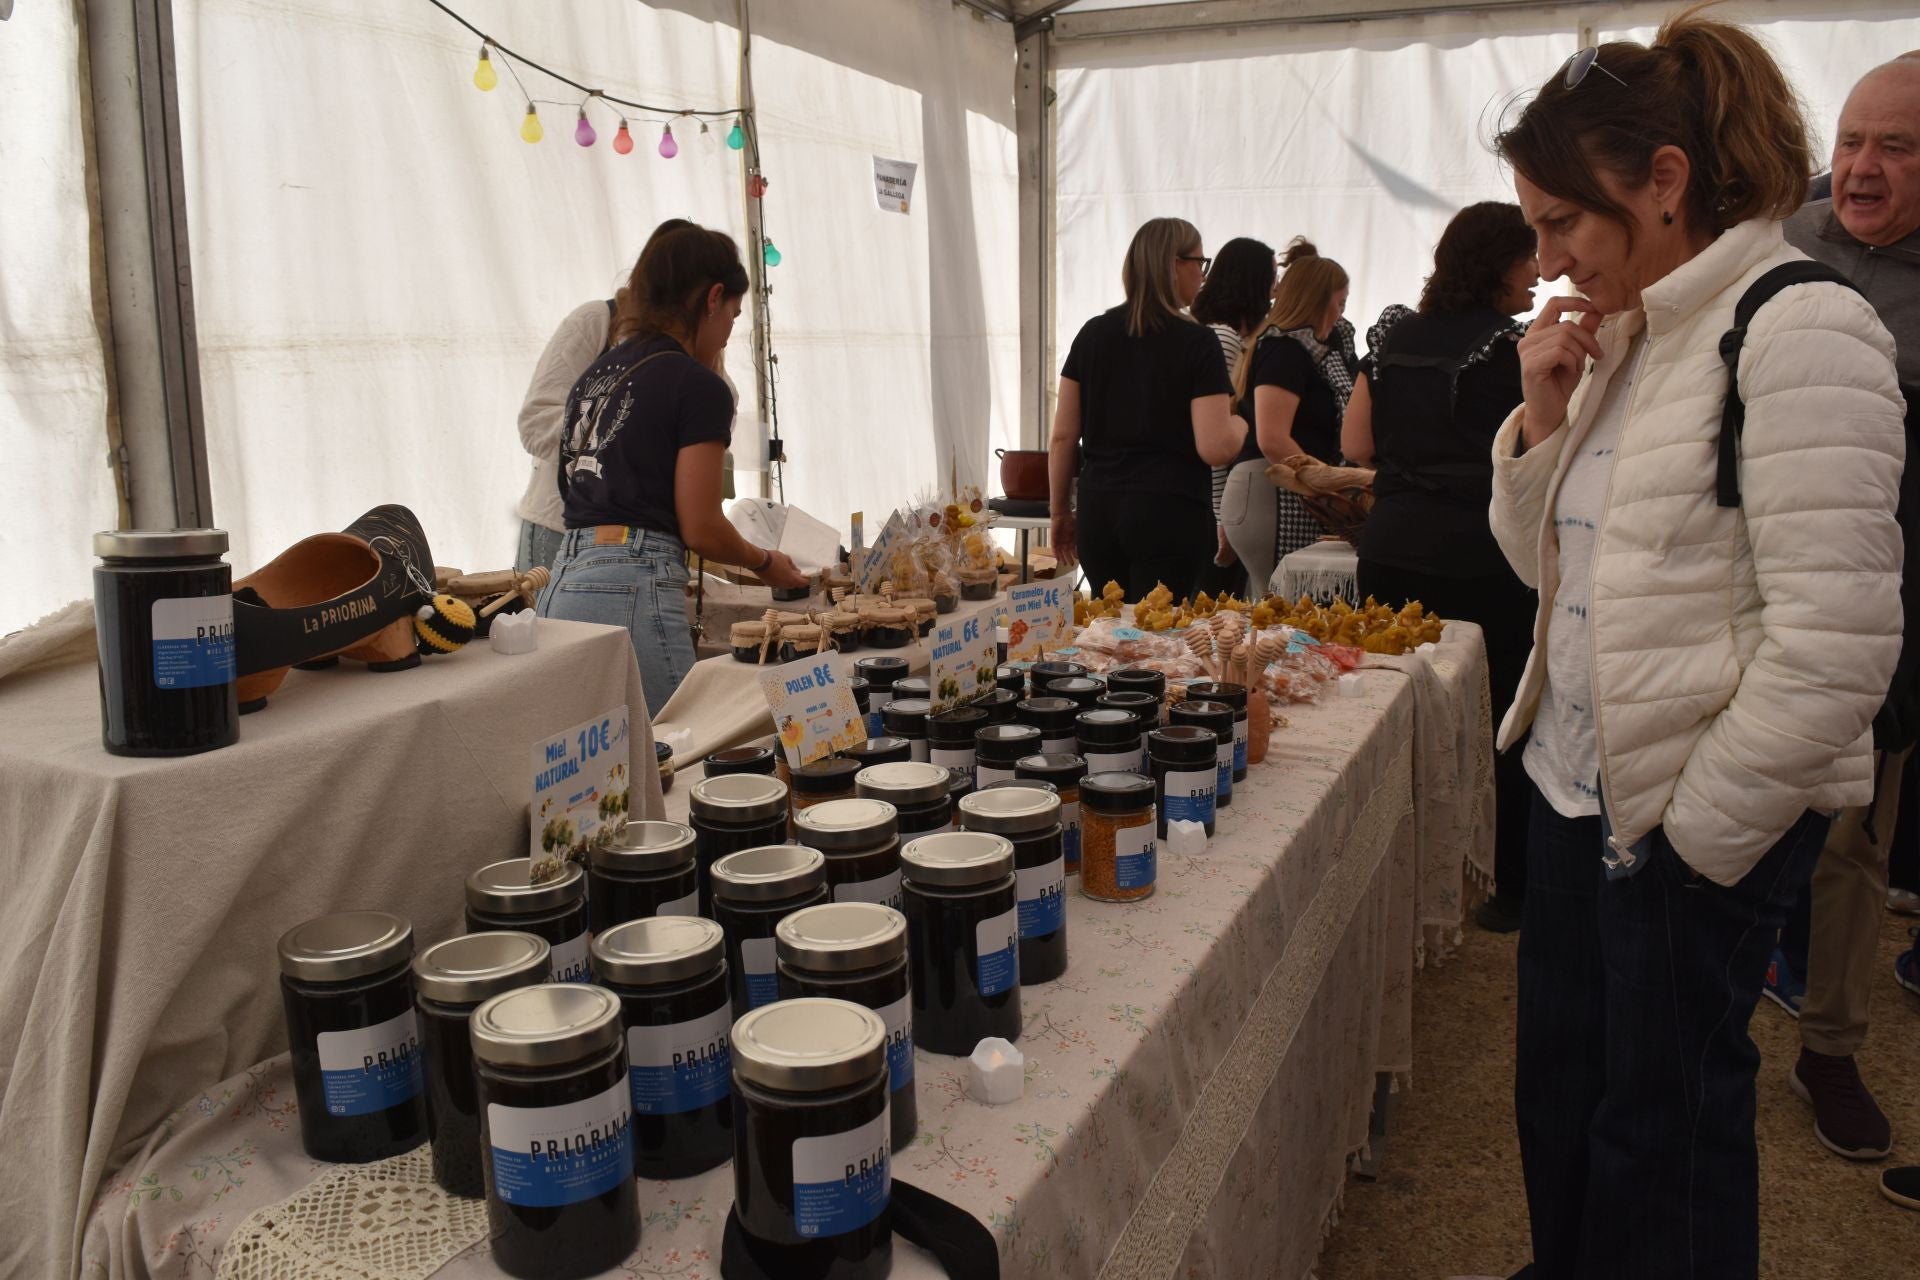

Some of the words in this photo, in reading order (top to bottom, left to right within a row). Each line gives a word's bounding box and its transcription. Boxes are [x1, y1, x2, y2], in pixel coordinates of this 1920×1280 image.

[1011, 587, 1044, 601] Caramelos
[1044, 587, 1060, 608] 4€
[1015, 603, 1027, 613] con
[1027, 599, 1042, 610] Miel
[303, 618, 319, 634] La
[321, 595, 378, 629] PRIORINA
[938, 626, 953, 643] Miel
[963, 617, 980, 642] 6€
[932, 639, 962, 661] NATURAL
[785, 674, 814, 695] POLEN
[812, 663, 835, 688] 8€
[545, 739, 567, 763] Miel
[577, 719, 611, 763] 10€
[535, 757, 580, 793] NATURAL
[531, 1111, 629, 1163] PRIORINA
